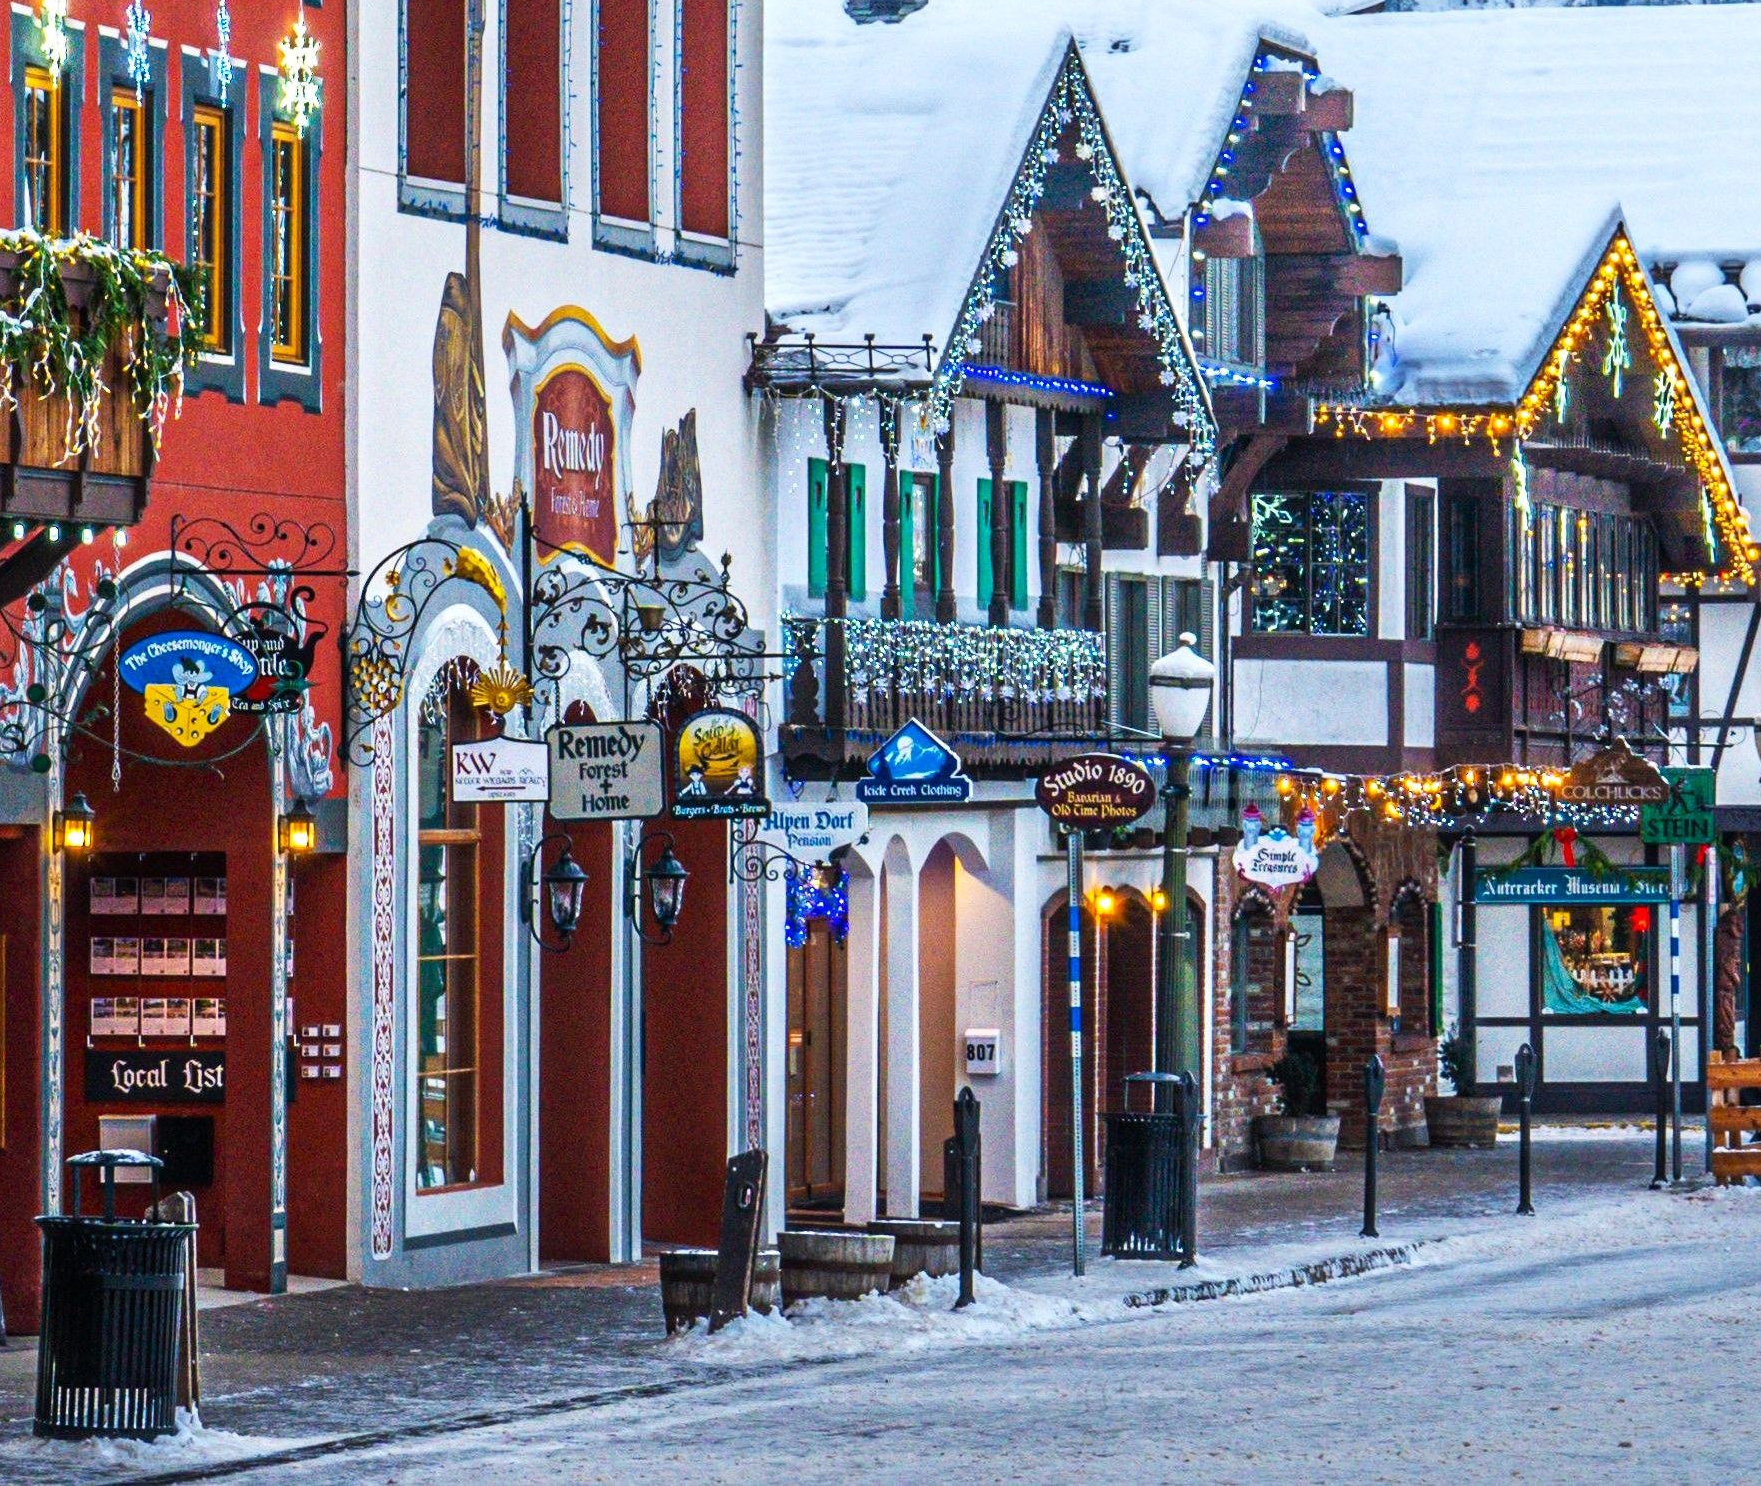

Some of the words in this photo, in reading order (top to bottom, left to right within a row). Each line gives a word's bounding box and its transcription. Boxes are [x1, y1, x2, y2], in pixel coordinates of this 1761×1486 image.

[542, 411, 604, 490] Remedy
[124, 653, 147, 671] The
[147, 638, 228, 658] Cheesemonger's
[228, 647, 254, 676] Shop
[231, 697, 249, 710] Tea
[558, 726, 645, 762] Remedy
[455, 752, 497, 775] KW
[580, 762, 628, 780] Forest
[1043, 759, 1103, 797] Studio
[1108, 764, 1146, 794] 1890
[864, 783, 887, 797] Icicle
[890, 783, 917, 797] Creek
[920, 783, 962, 798] Clothing
[1067, 790, 1112, 804] Bavarian
[582, 794, 630, 813] Home
[672, 804, 706, 818] Burgers
[711, 803, 735, 815] Brats
[739, 802, 767, 814] Brews
[1051, 803, 1072, 816] Old
[1073, 803, 1098, 817] Time
[1100, 804, 1137, 818] Photos
[763, 811, 810, 832] Alpen
[811, 811, 856, 830] Dorf
[1647, 818, 1709, 839] STEIN
[787, 833, 832, 848] Pension
[1257, 847, 1296, 863] Simple
[1482, 876, 1558, 897] Nutcracker
[1565, 874, 1621, 897] Museum
[966, 1043, 995, 1061] 807
[110, 1059, 170, 1094] Local
[183, 1059, 225, 1094] List
